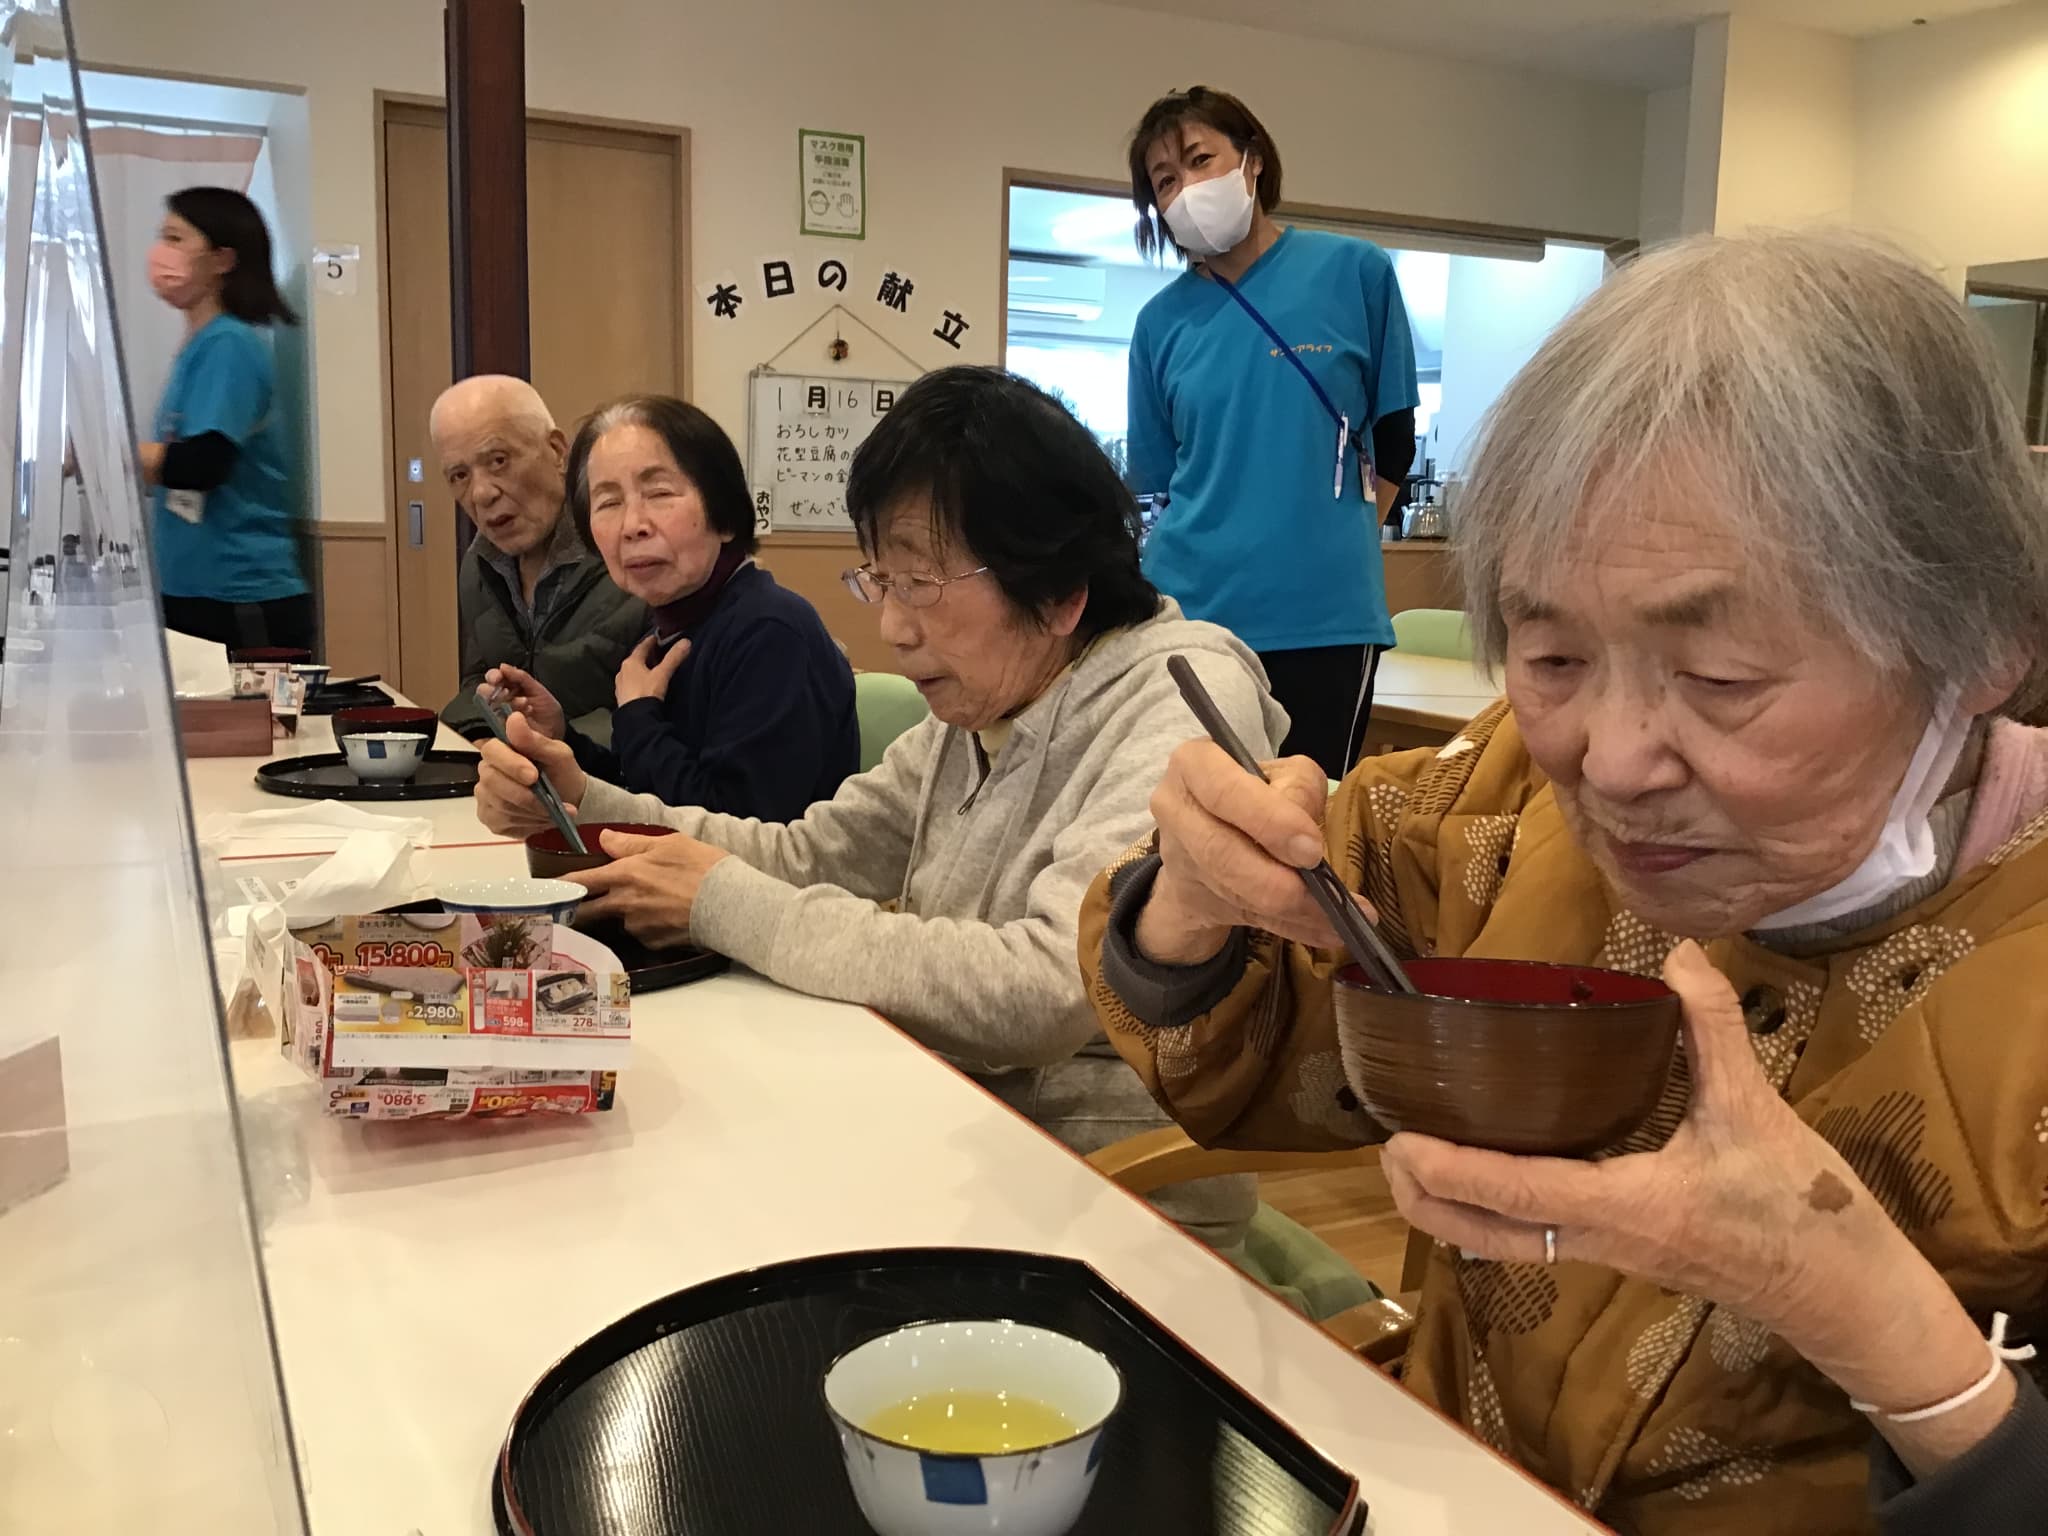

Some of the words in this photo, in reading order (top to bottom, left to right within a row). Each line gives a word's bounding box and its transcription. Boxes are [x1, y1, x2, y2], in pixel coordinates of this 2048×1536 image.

[328, 254, 343, 279] 5
[707, 260, 970, 349] 本日の献立
[1270, 343, 1333, 358] サアライフ
[776, 423, 849, 440] おろしカツ
[757, 491, 770, 529] おやつ
[357, 941, 451, 968] 15,800円
